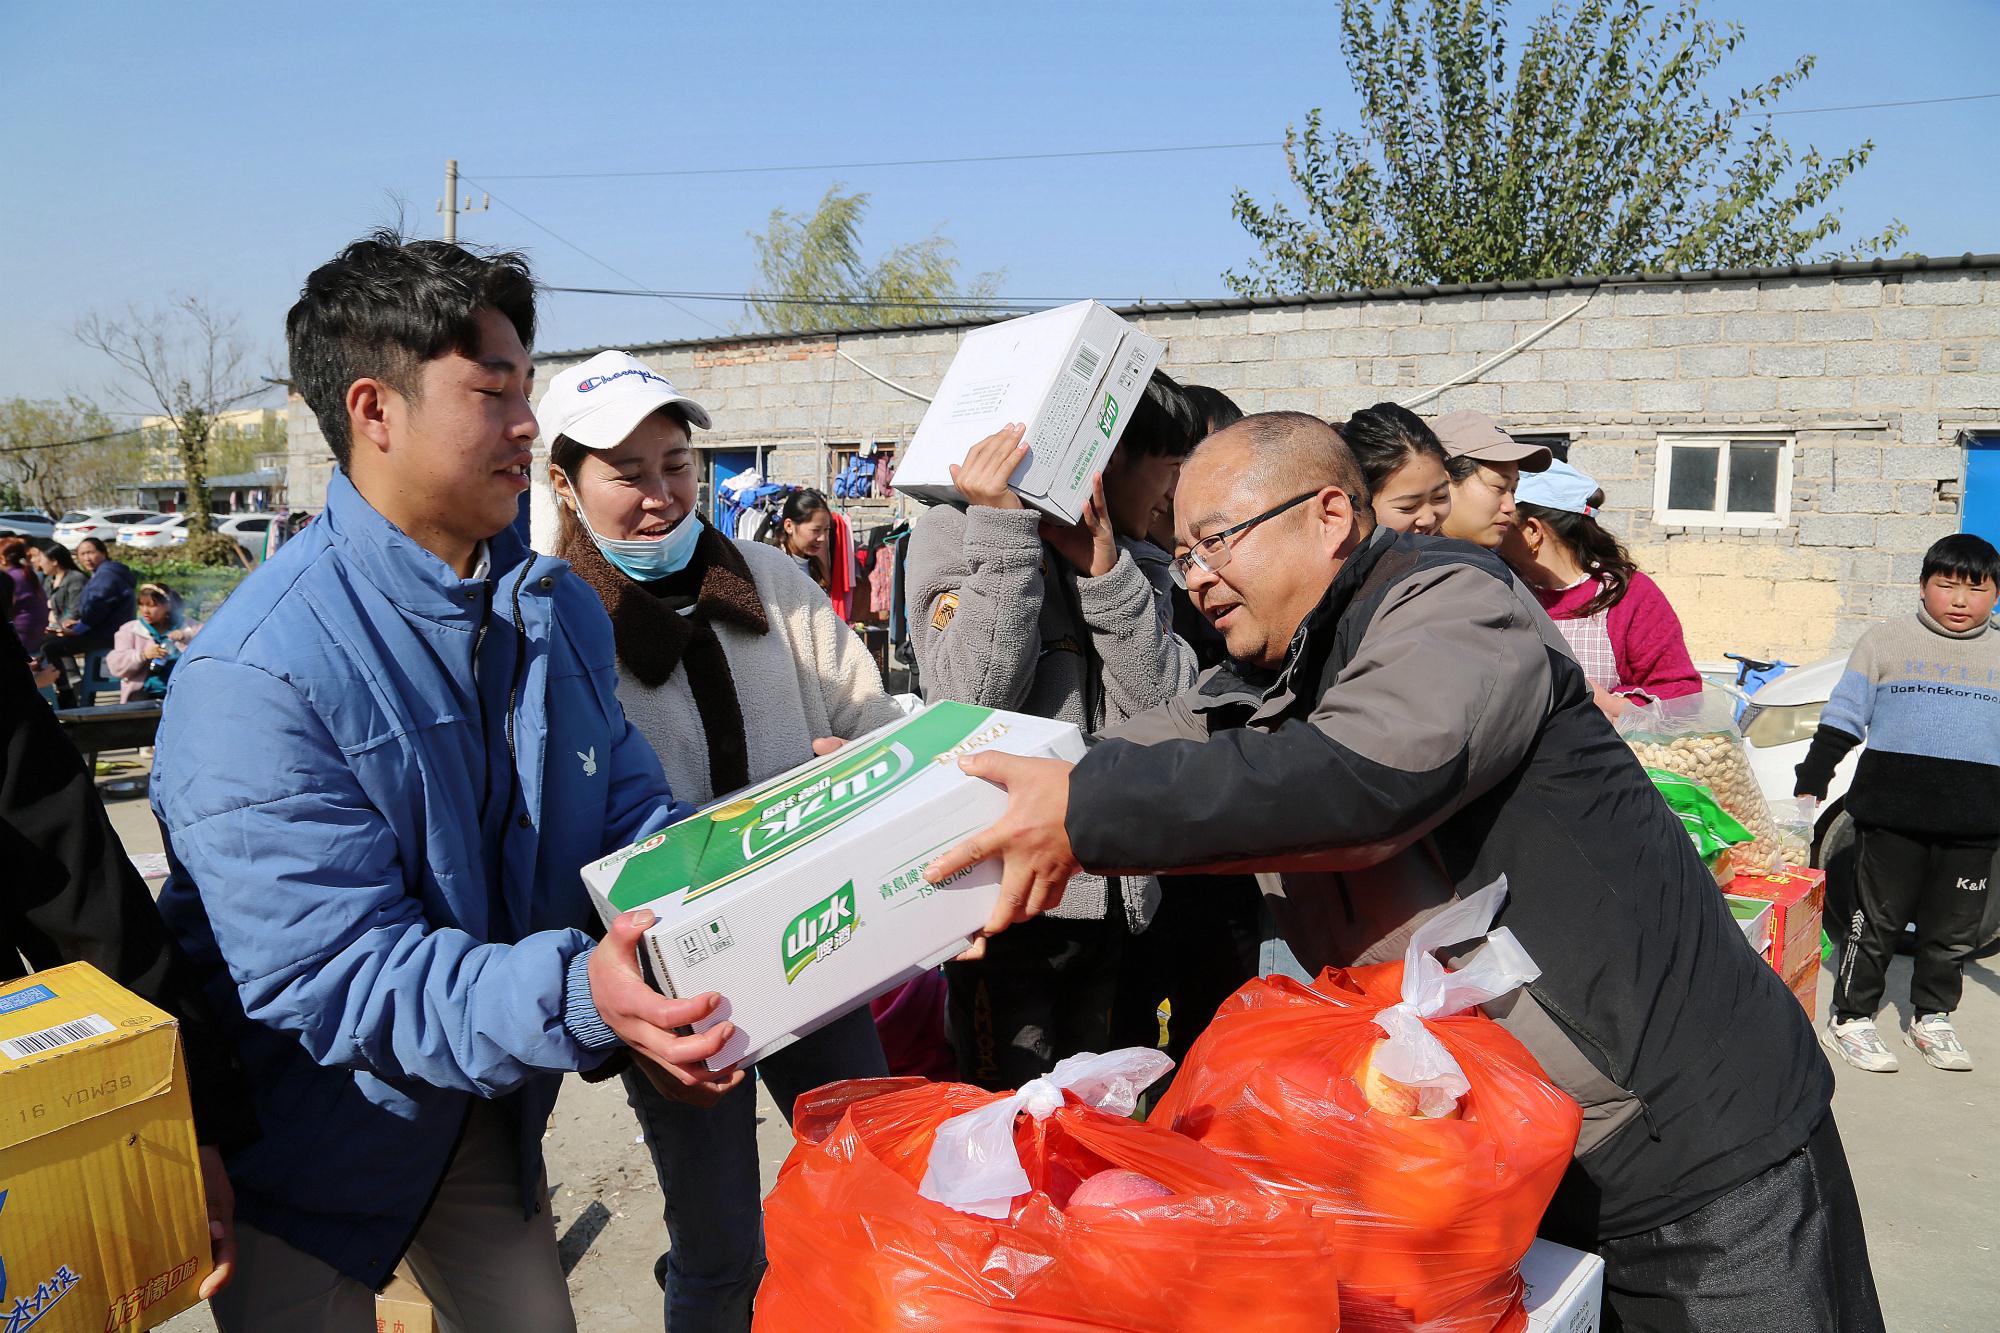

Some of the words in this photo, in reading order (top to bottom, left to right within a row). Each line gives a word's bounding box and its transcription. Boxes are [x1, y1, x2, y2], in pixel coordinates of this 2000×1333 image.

[918, 863, 973, 899] TSINGTAO
[1956, 877, 1988, 891] K&K
[787, 895, 853, 958] 山水
[816, 924, 852, 963] 啤酒
[104, 1256, 199, 1333] 柠檬口味
